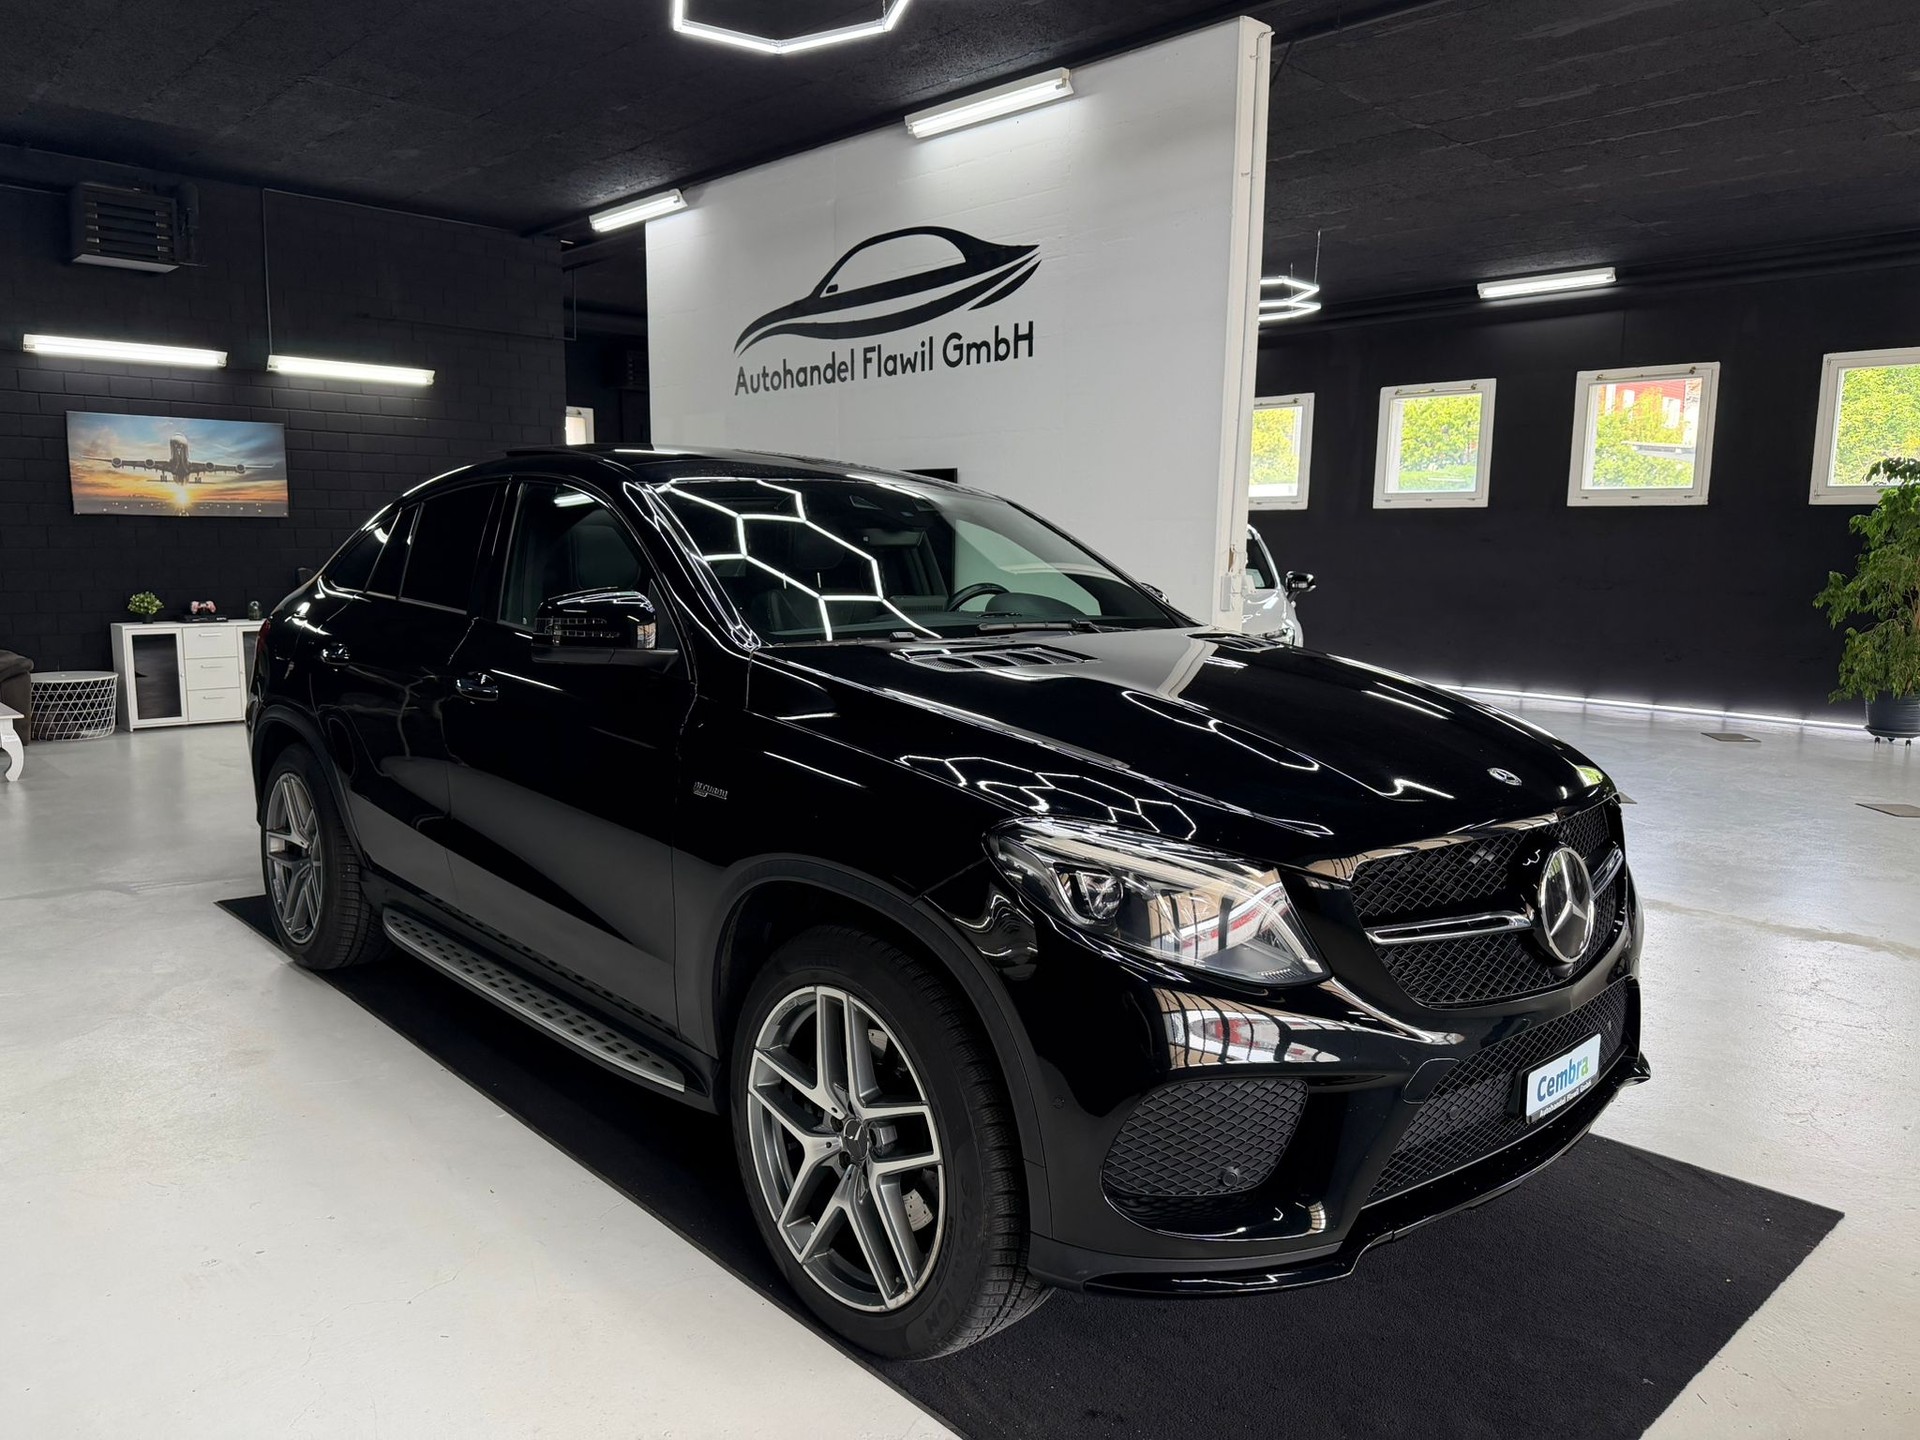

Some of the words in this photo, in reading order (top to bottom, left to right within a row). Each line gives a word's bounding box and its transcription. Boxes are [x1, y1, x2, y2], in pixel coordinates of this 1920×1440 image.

[734, 350, 855, 396] Autohandel
[862, 336, 934, 380] Flawil
[942, 320, 1034, 369] GmbH
[1537, 1056, 1589, 1102] Cembra
